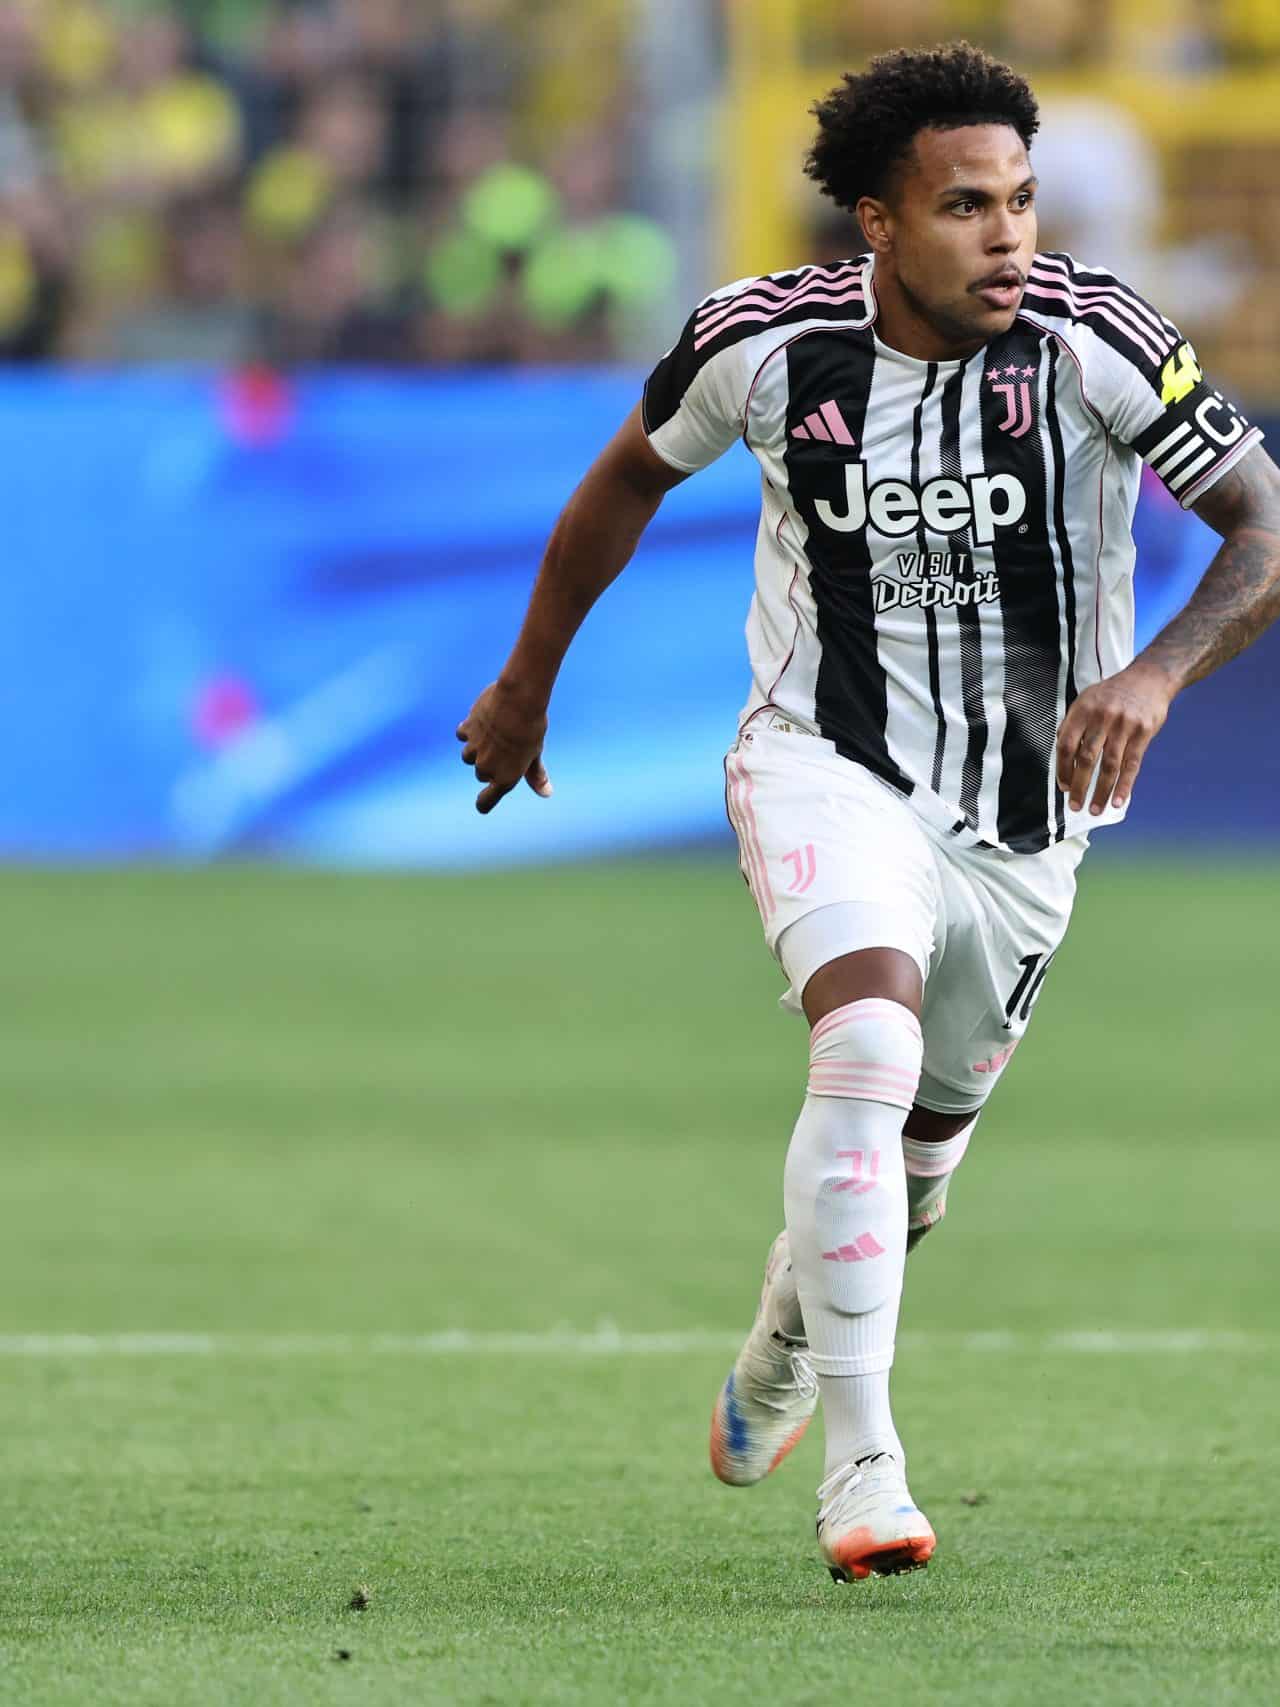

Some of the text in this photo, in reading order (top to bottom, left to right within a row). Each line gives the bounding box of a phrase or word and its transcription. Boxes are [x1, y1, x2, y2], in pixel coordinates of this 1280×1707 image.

[813, 463, 1027, 544] Jeep
[897, 552, 969, 577] VISIT
[873, 575, 1001, 613] Detroit
